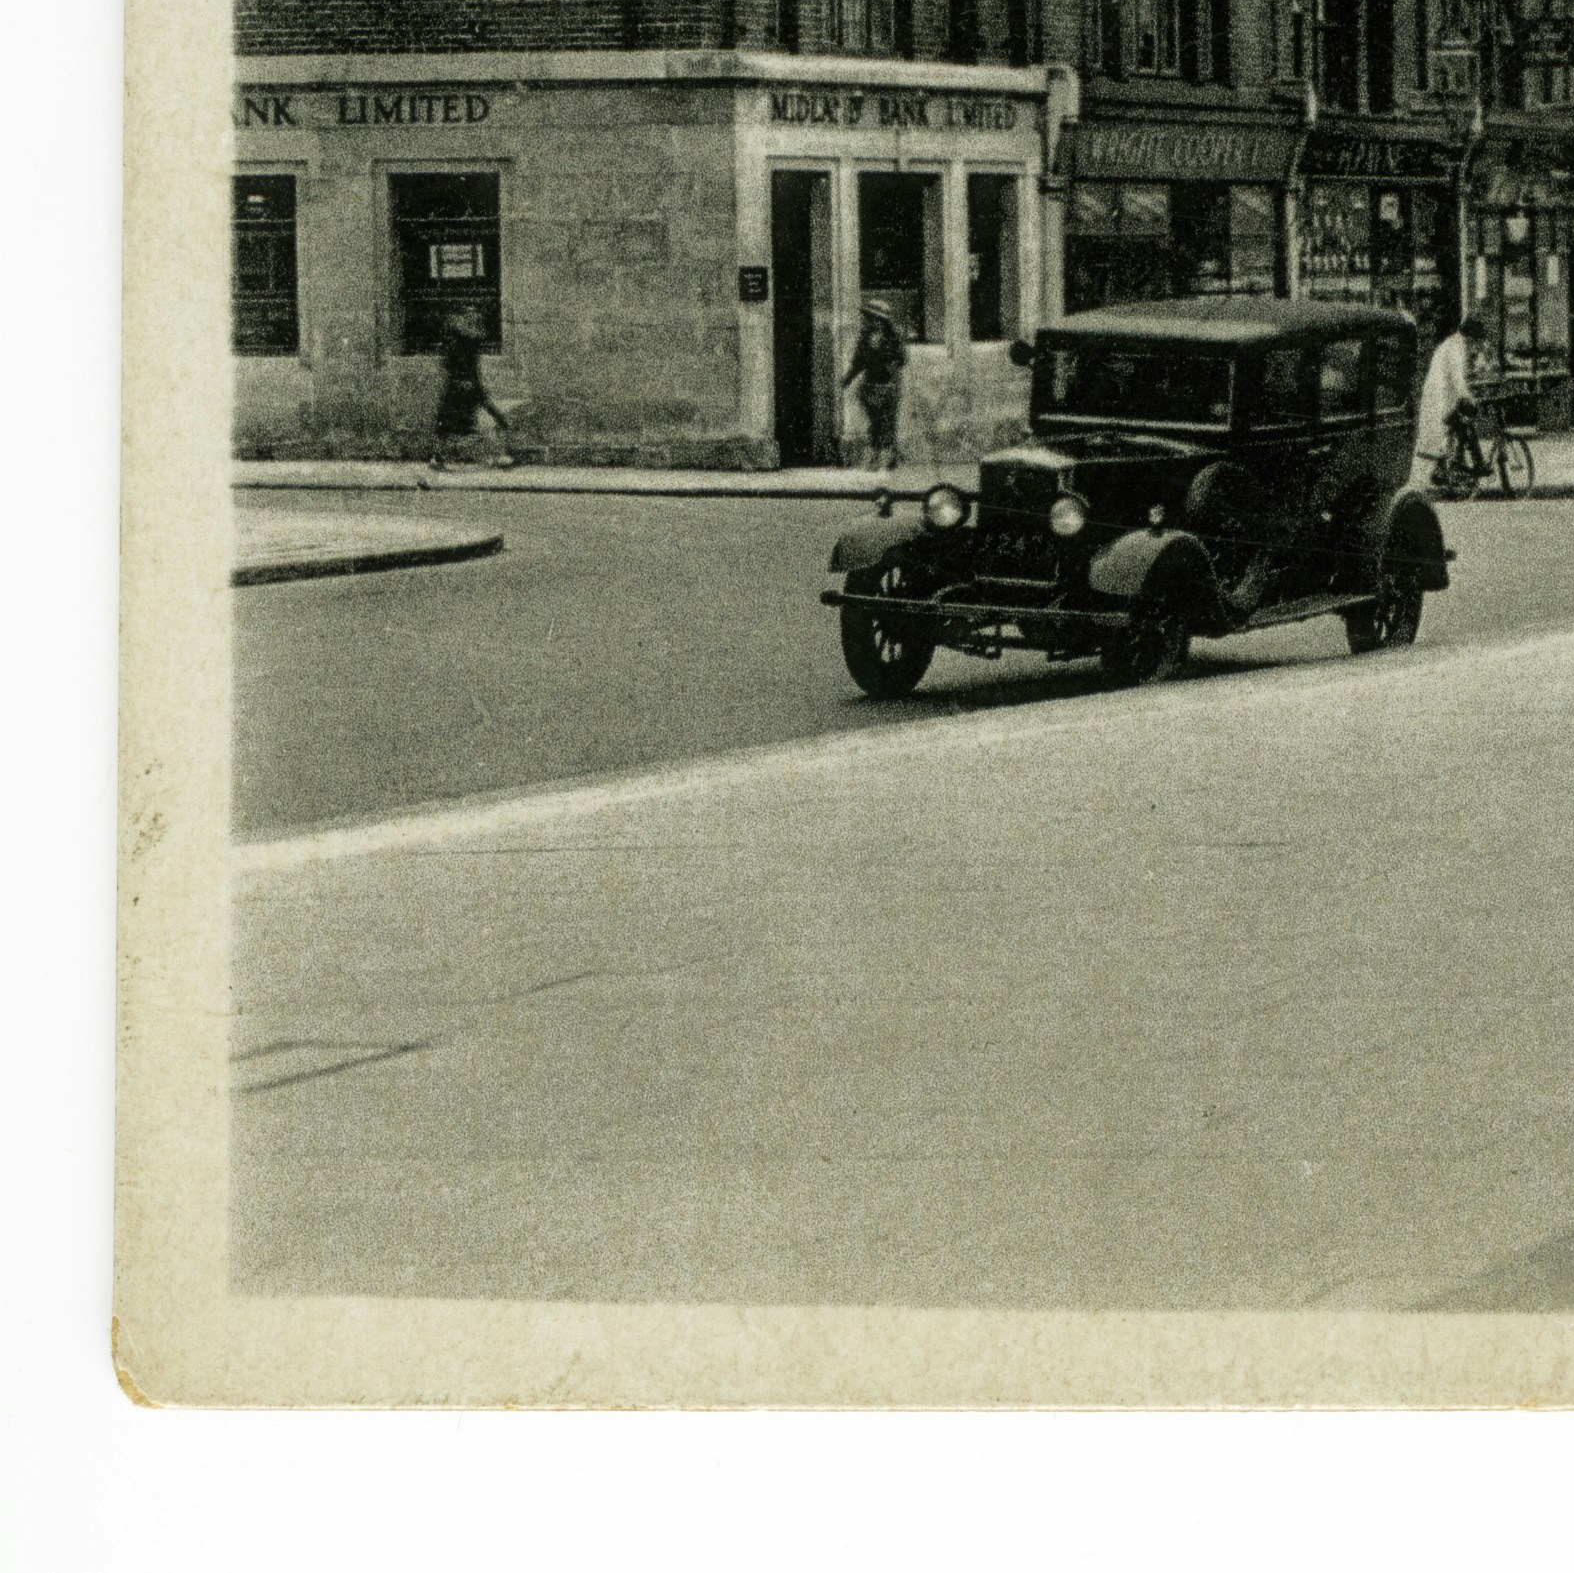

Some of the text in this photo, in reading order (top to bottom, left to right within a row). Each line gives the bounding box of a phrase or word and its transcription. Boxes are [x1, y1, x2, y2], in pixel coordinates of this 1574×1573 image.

[236, 95, 490, 127] NK LIMITED
[879, 96, 930, 127] BANK
